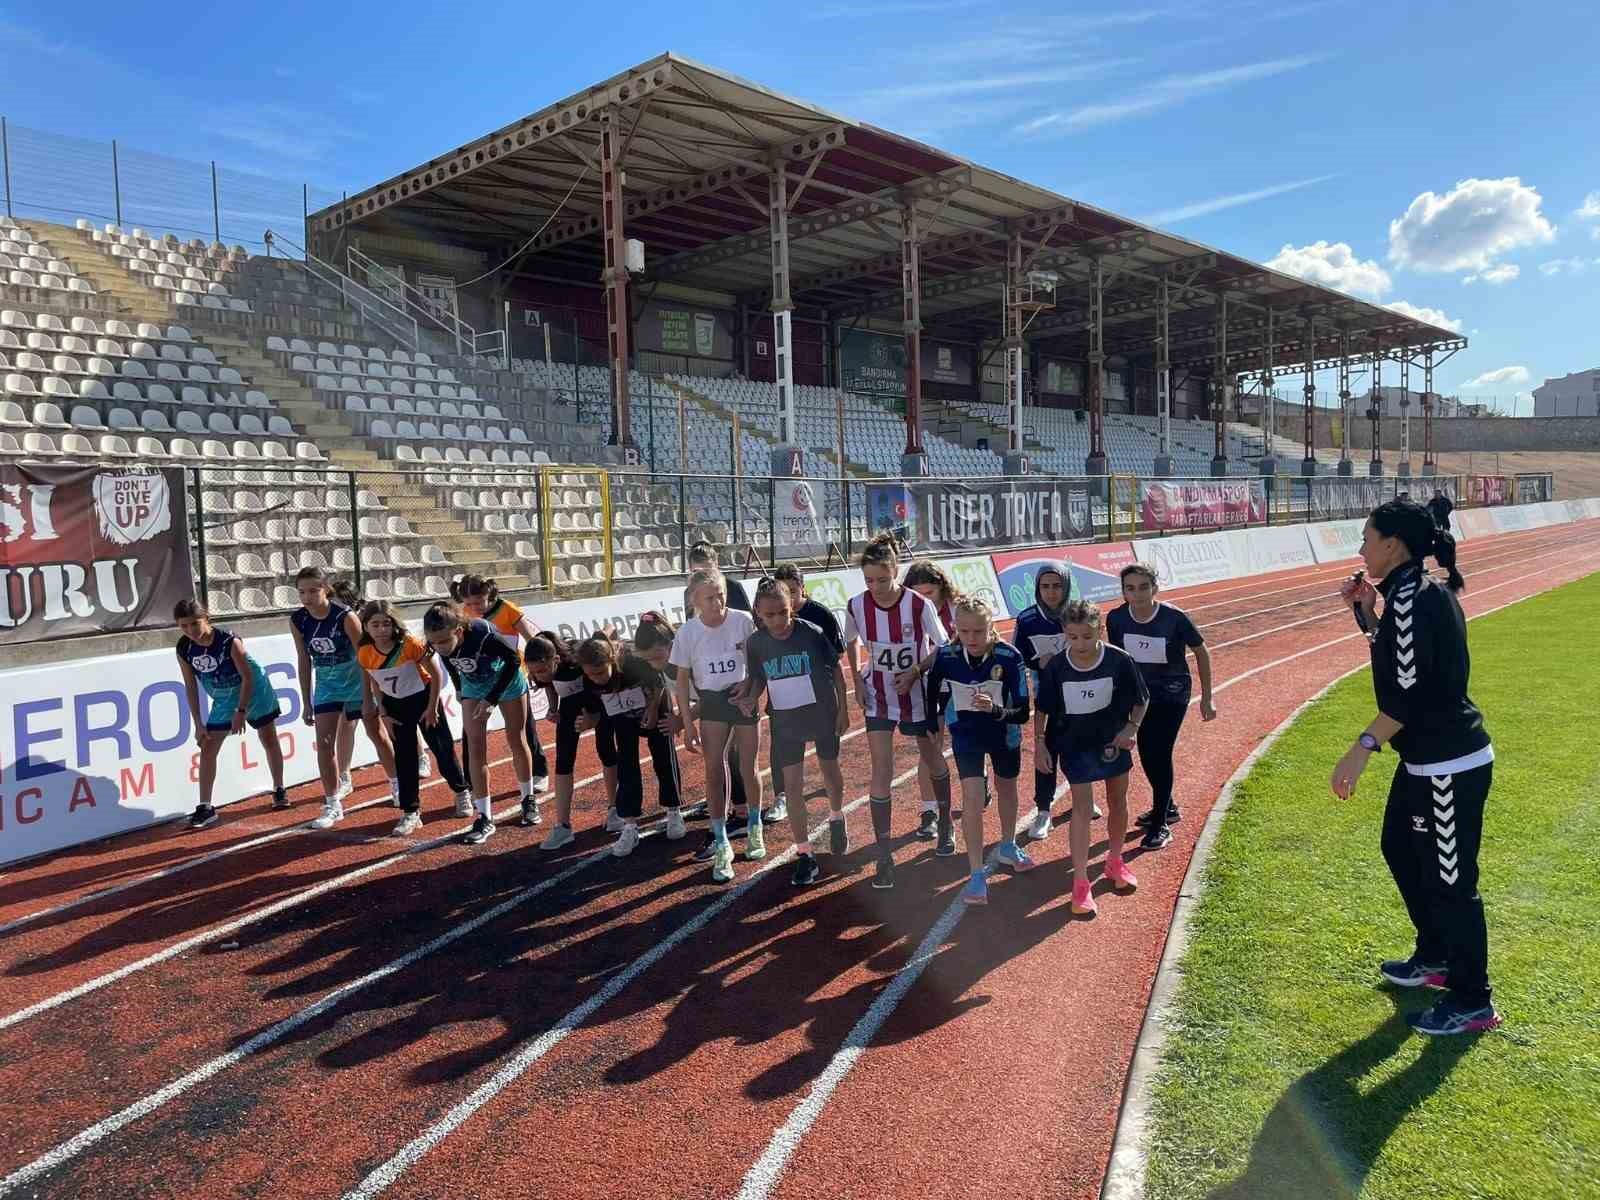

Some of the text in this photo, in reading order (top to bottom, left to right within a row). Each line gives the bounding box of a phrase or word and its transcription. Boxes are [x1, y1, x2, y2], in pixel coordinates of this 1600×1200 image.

[791, 455, 802, 473] A
[920, 455, 929, 475] N
[1020, 456, 1028, 474] D
[114, 480, 150, 491] DON'T
[114, 491, 151, 505] GIVE
[115, 505, 150, 528] UP
[1000, 490, 1062, 538] TAYFA
[708, 659, 736, 674] 119
[877, 647, 913, 671] 46
[384, 675, 399, 694] 7
[1080, 689, 1095, 699] 76
